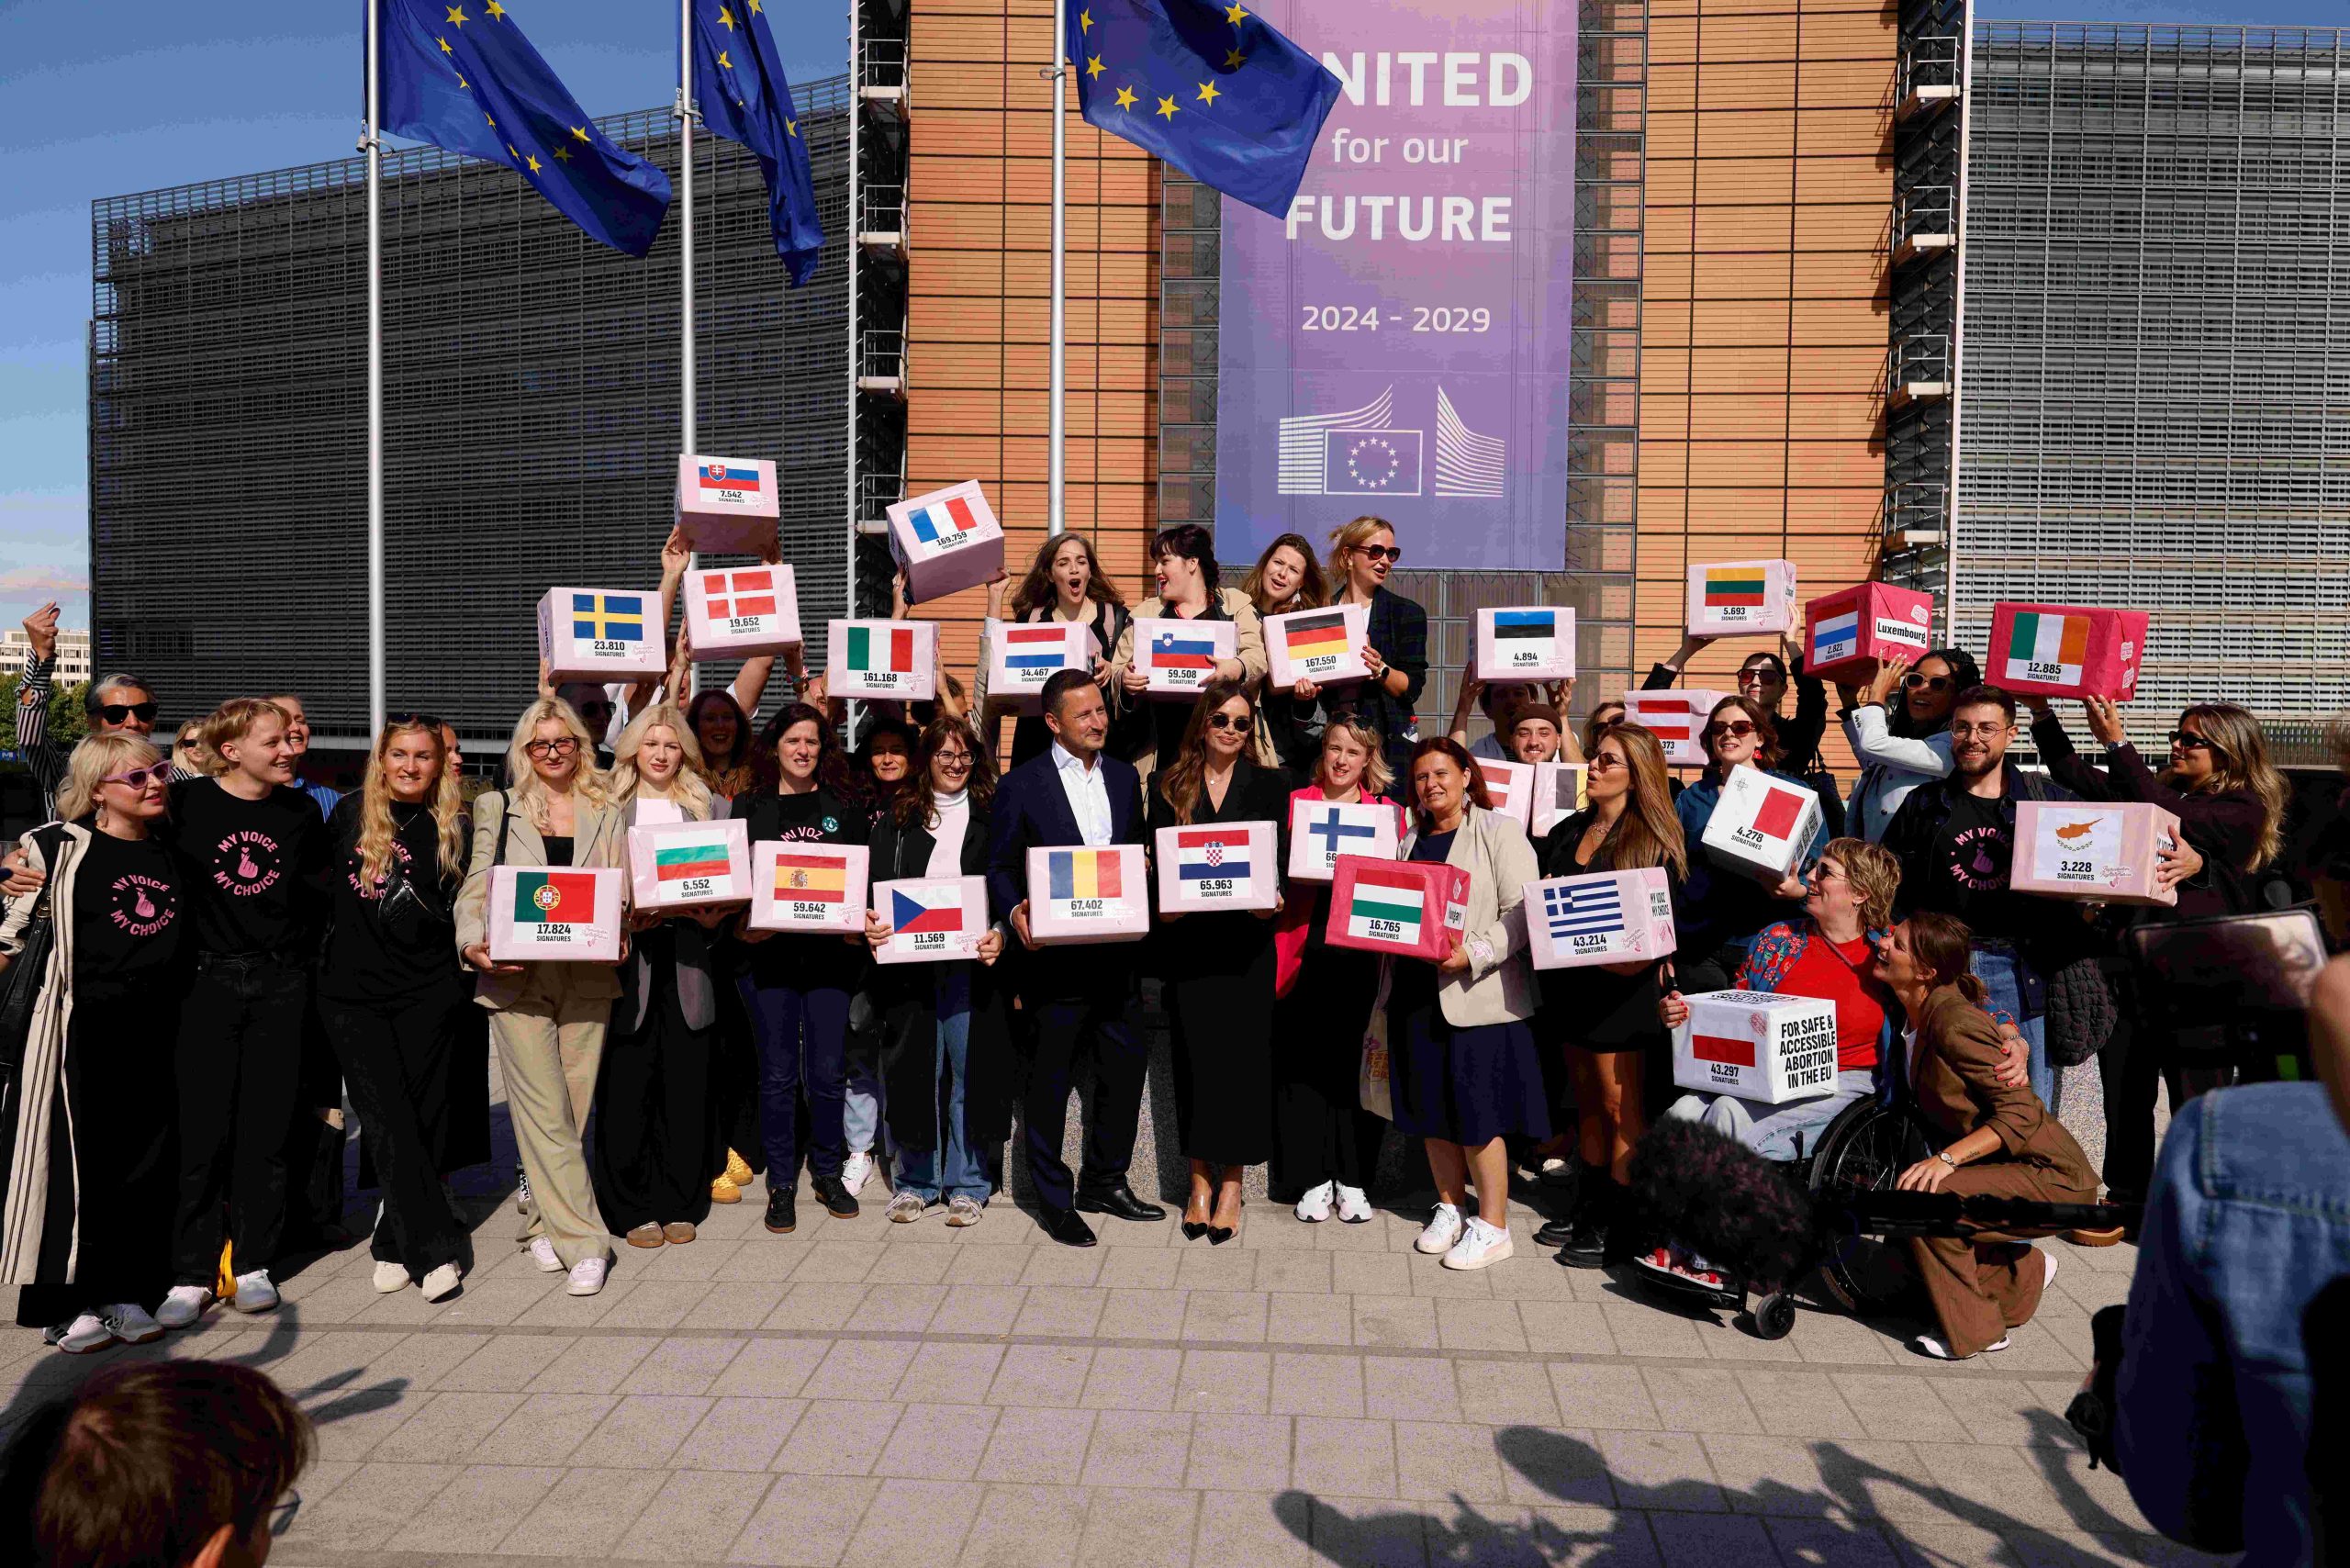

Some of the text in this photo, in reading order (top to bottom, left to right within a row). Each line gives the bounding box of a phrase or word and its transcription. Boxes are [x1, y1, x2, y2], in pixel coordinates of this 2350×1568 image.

[1309, 51, 1533, 106] NITED
[1331, 128, 1470, 163] for our
[1285, 196, 1512, 241] FUTURE
[1302, 306, 1380, 331] 2024
[1412, 307, 1491, 332] 2029
[720, 490, 743, 499] 7.542
[936, 531, 968, 547] 169.759
[941, 538, 968, 550] SIGNATURES
[1723, 607, 1746, 616] 5.693
[729, 617, 760, 629] 19.652
[730, 626, 761, 635] SIGNATURES
[1876, 622, 1927, 644] Luxembourg
[594, 641, 625, 651] 23.810
[1305, 655, 1337, 667] 167.550
[1514, 652, 1538, 661] 4.894
[1021, 668, 1049, 677] 34.467
[1168, 669, 1197, 679] 59.508
[1308, 665, 1336, 674] SIGNATURES
[2027, 662, 2062, 675] 12.885
[863, 672, 898, 682] 161.168
[2027, 673, 2061, 682] SIGNATURES
[797, 826, 823, 841] VOZ
[1736, 826, 1764, 843] 4.278
[1954, 829, 1975, 846] MY
[218, 831, 279, 853] MY VOICE
[1730, 834, 1762, 850] SIGNATURES
[1950, 863, 1970, 882] MY
[2061, 861, 2092, 873] 3.228
[213, 869, 281, 896] MY CHOICE
[2056, 872, 2095, 881] SIGNATURES
[112, 875, 171, 891] MY VOICE
[683, 879, 711, 890] 6.552
[1200, 879, 1233, 890] 65.963
[681, 889, 713, 899] SIGNATURES
[1201, 890, 1233, 898] SIGNATURES
[793, 902, 826, 913] 59.642
[1070, 900, 1103, 911] 67.402
[110, 908, 175, 936] MY CHOICE
[793, 913, 825, 921] SIGNATURES
[536, 924, 572, 935] 17.824
[1369, 919, 1401, 933] 16.765
[536, 935, 572, 943] SIGNATURES
[913, 933, 946, 944] 11.569
[1368, 930, 1400, 940] SIGNATURES
[1572, 934, 1607, 947] 43.214
[1574, 946, 1607, 956] SIGNATURES
[1781, 1021, 1801, 1038] FOR
[1800, 1015, 1827, 1035] SAFE
[1827, 1014, 1834, 1030] &
[1779, 1030, 1836, 1057] ACCESSIBLE
[1785, 1047, 1833, 1072] ABORTION
[1710, 1063, 1740, 1078] 43.297
[1711, 1075, 1740, 1086] SIGNATURES
[1787, 1065, 1832, 1090] IN THE EU
